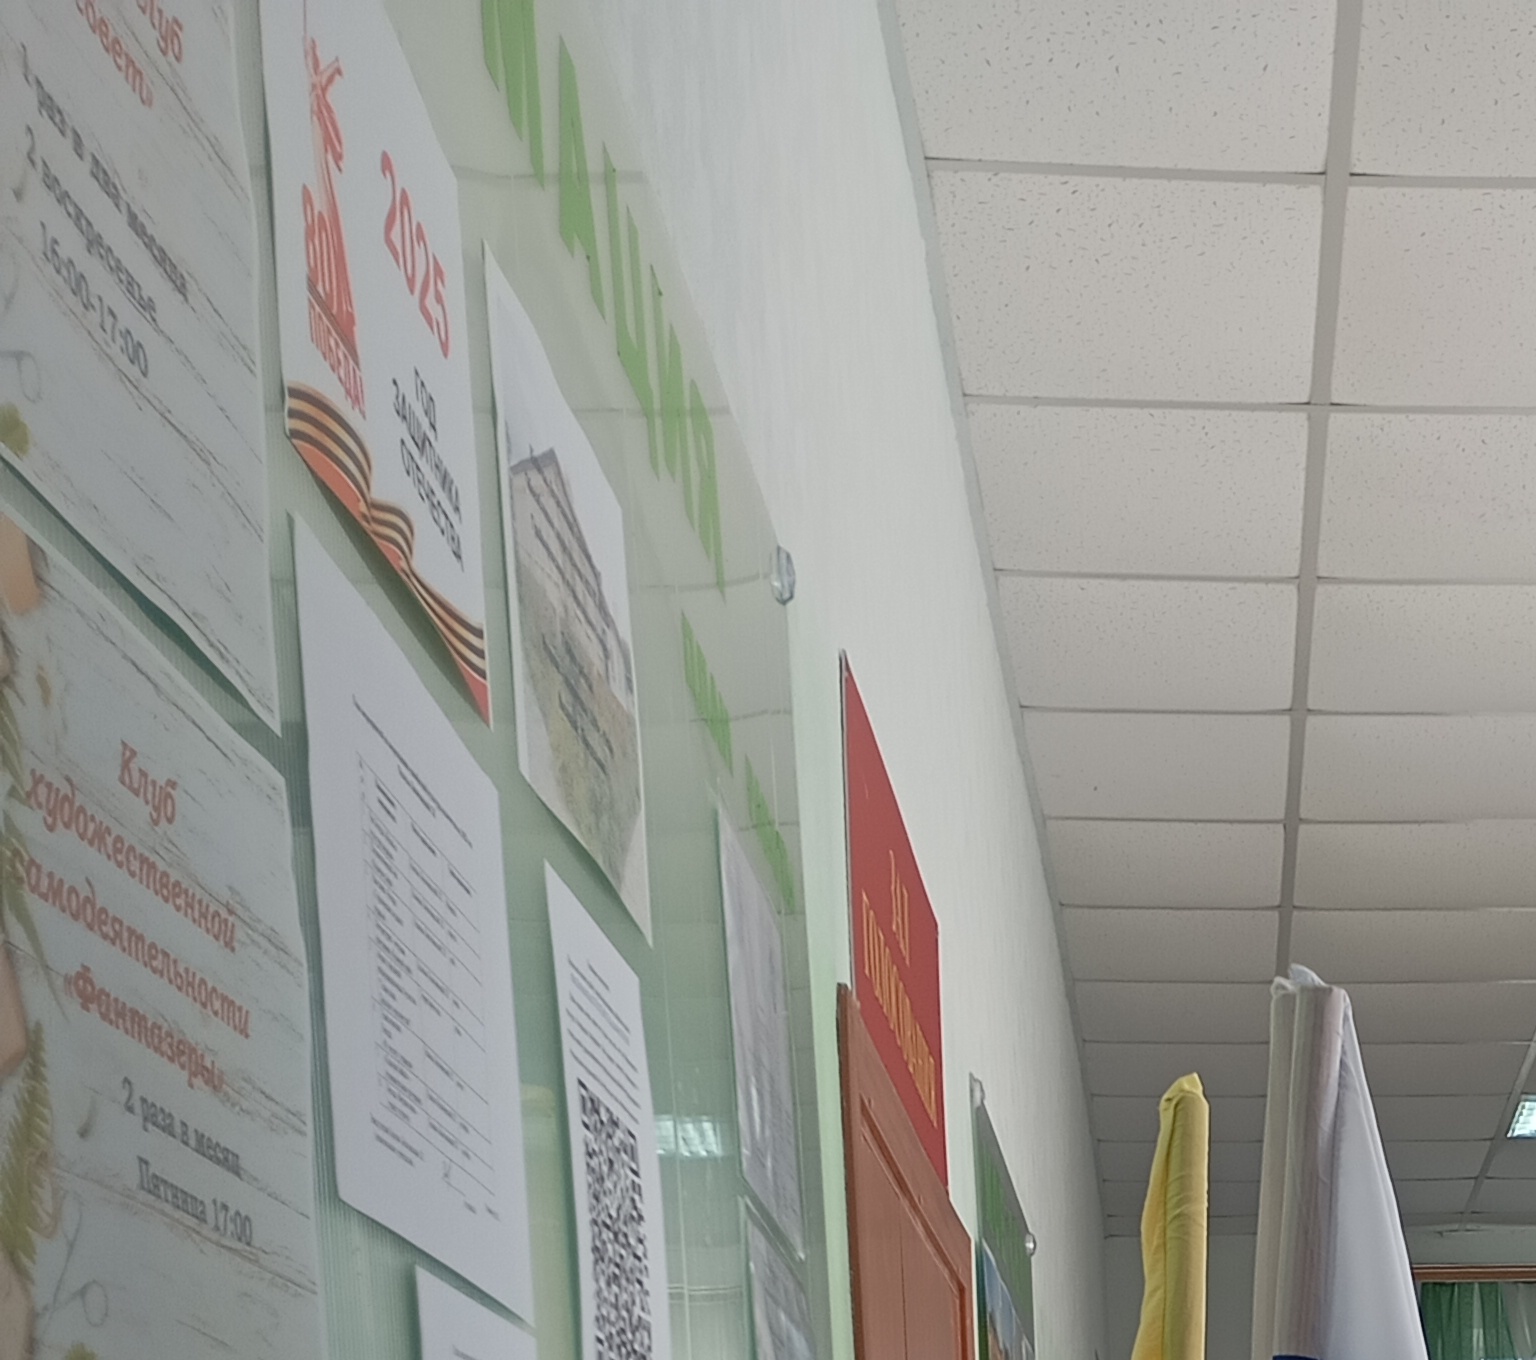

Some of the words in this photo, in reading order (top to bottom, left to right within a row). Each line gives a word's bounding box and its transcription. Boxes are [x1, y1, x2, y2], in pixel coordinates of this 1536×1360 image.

[25, 123, 37, 170] 2
[41, 155, 158, 318] воскресенье
[381, 150, 450, 359] 2025
[40, 219, 149, 379] 16:00-17:00
[308, 296, 367, 421] ПОБЕДА!
[392, 377, 463, 525] ЗАЩИТНИКА
[414, 366, 438, 441] ГОД
[400, 438, 464, 573] ОТЕЧЕСТВА
[118, 738, 178, 827] Клуб
[26, 768, 237, 954] художественной
[121, 1075, 136, 1117] 2
[139, 1095, 176, 1134] раза
[136, 1154, 208, 1226] Пятница
[211, 1197, 254, 1248] 17:00
